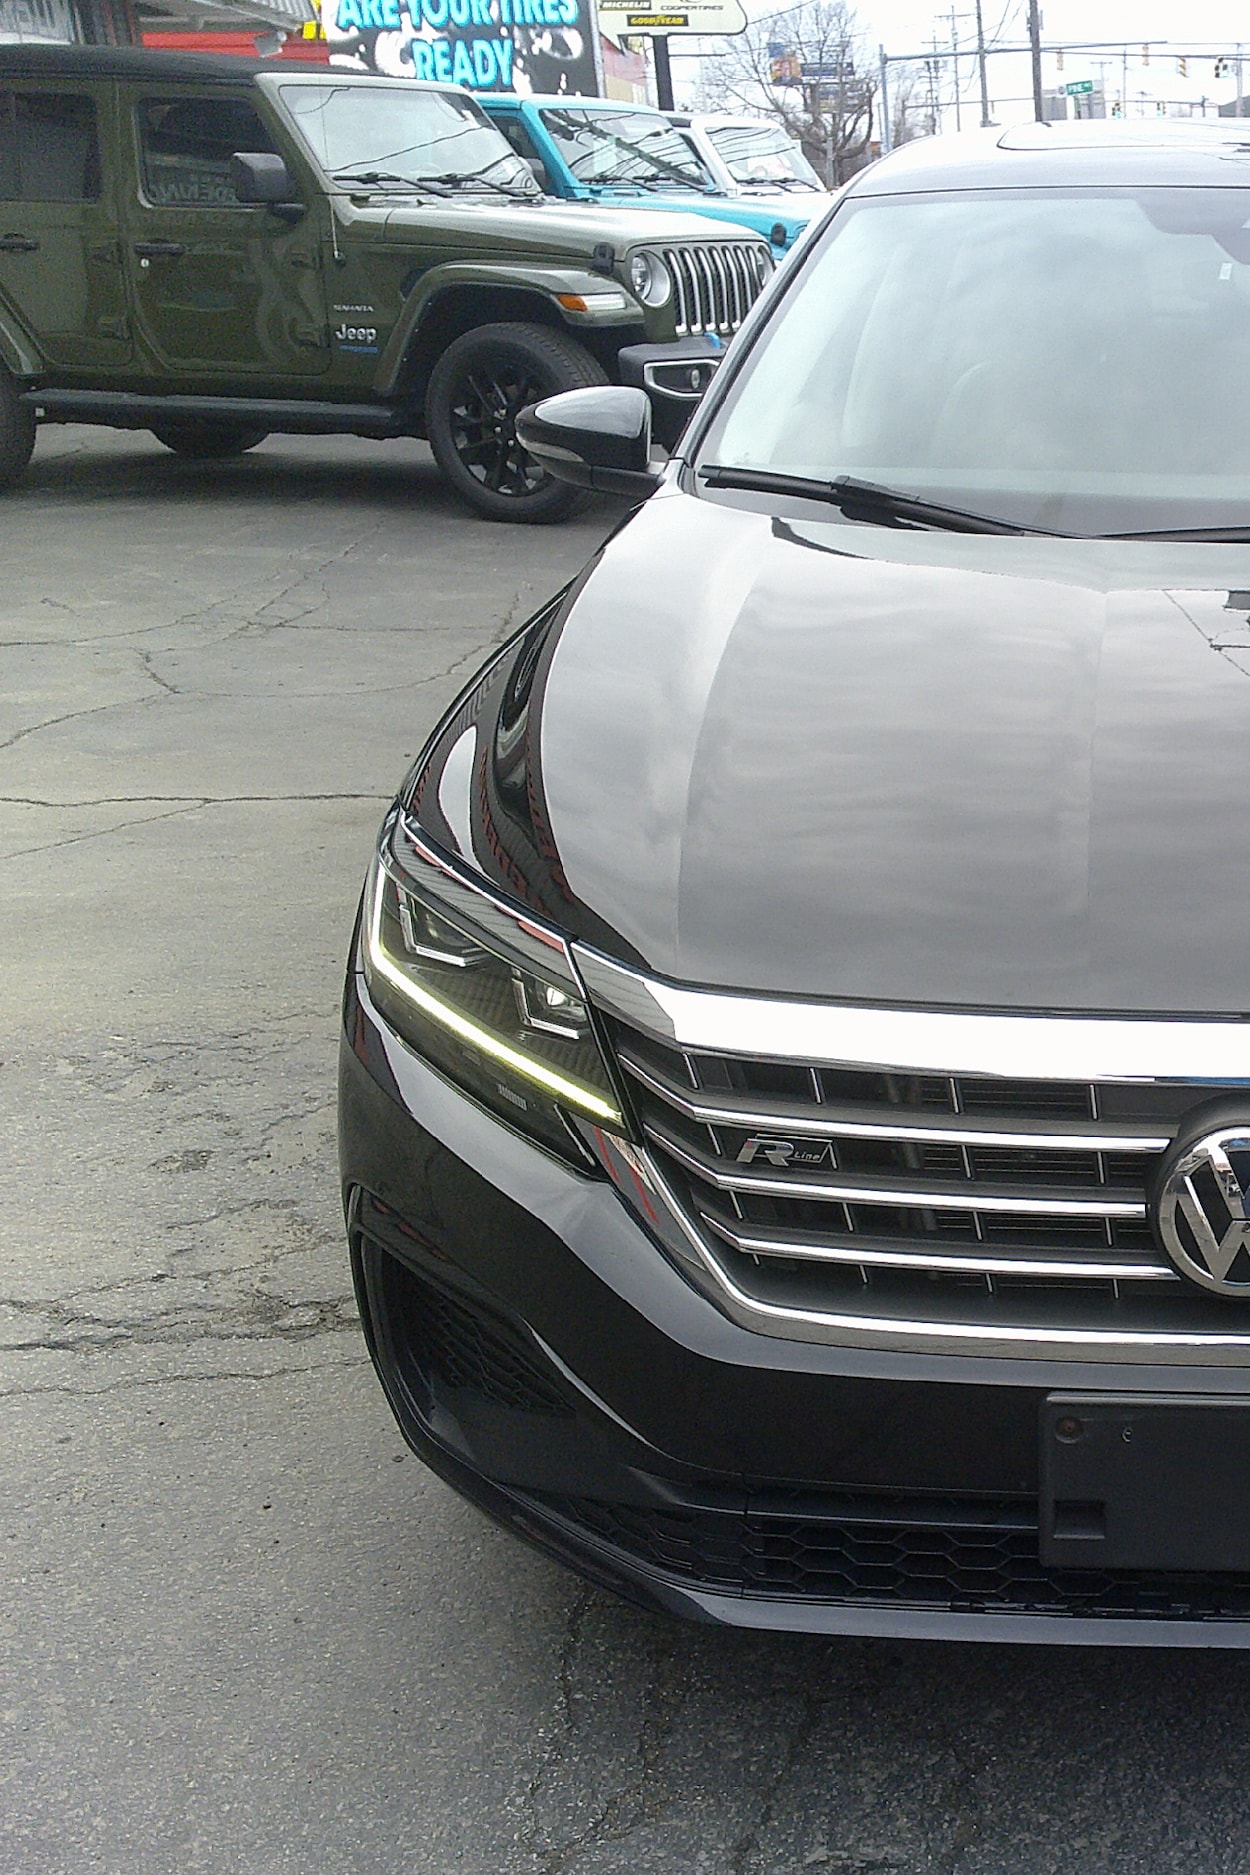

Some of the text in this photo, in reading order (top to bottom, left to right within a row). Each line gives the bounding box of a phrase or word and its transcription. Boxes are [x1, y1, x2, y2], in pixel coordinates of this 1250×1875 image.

[337, 0, 579, 28] ARE YOUR TIRES
[602, 1, 650, 9] MICHELIN
[630, 14, 684, 25] GOODYEAR
[411, 38, 513, 86] READY
[335, 323, 377, 344] Jeep
